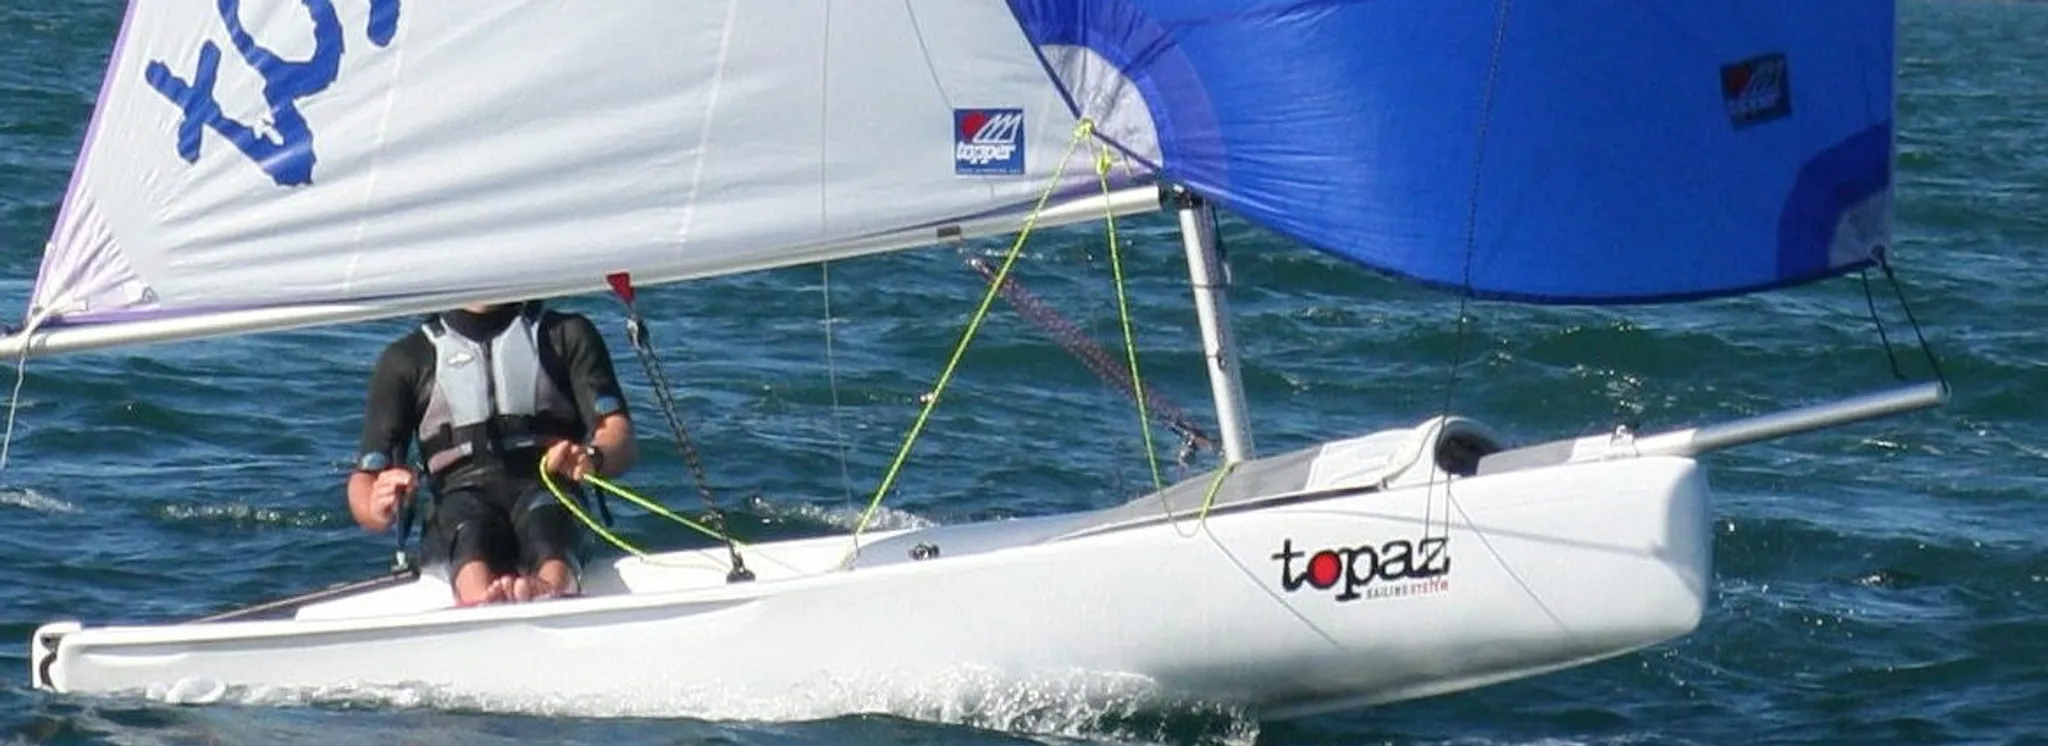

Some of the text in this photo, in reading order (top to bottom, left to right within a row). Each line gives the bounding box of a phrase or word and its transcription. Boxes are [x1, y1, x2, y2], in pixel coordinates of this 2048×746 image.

[144, 0, 401, 187] to
[956, 140, 1017, 165] topper
[1271, 538, 1450, 601] topaz
